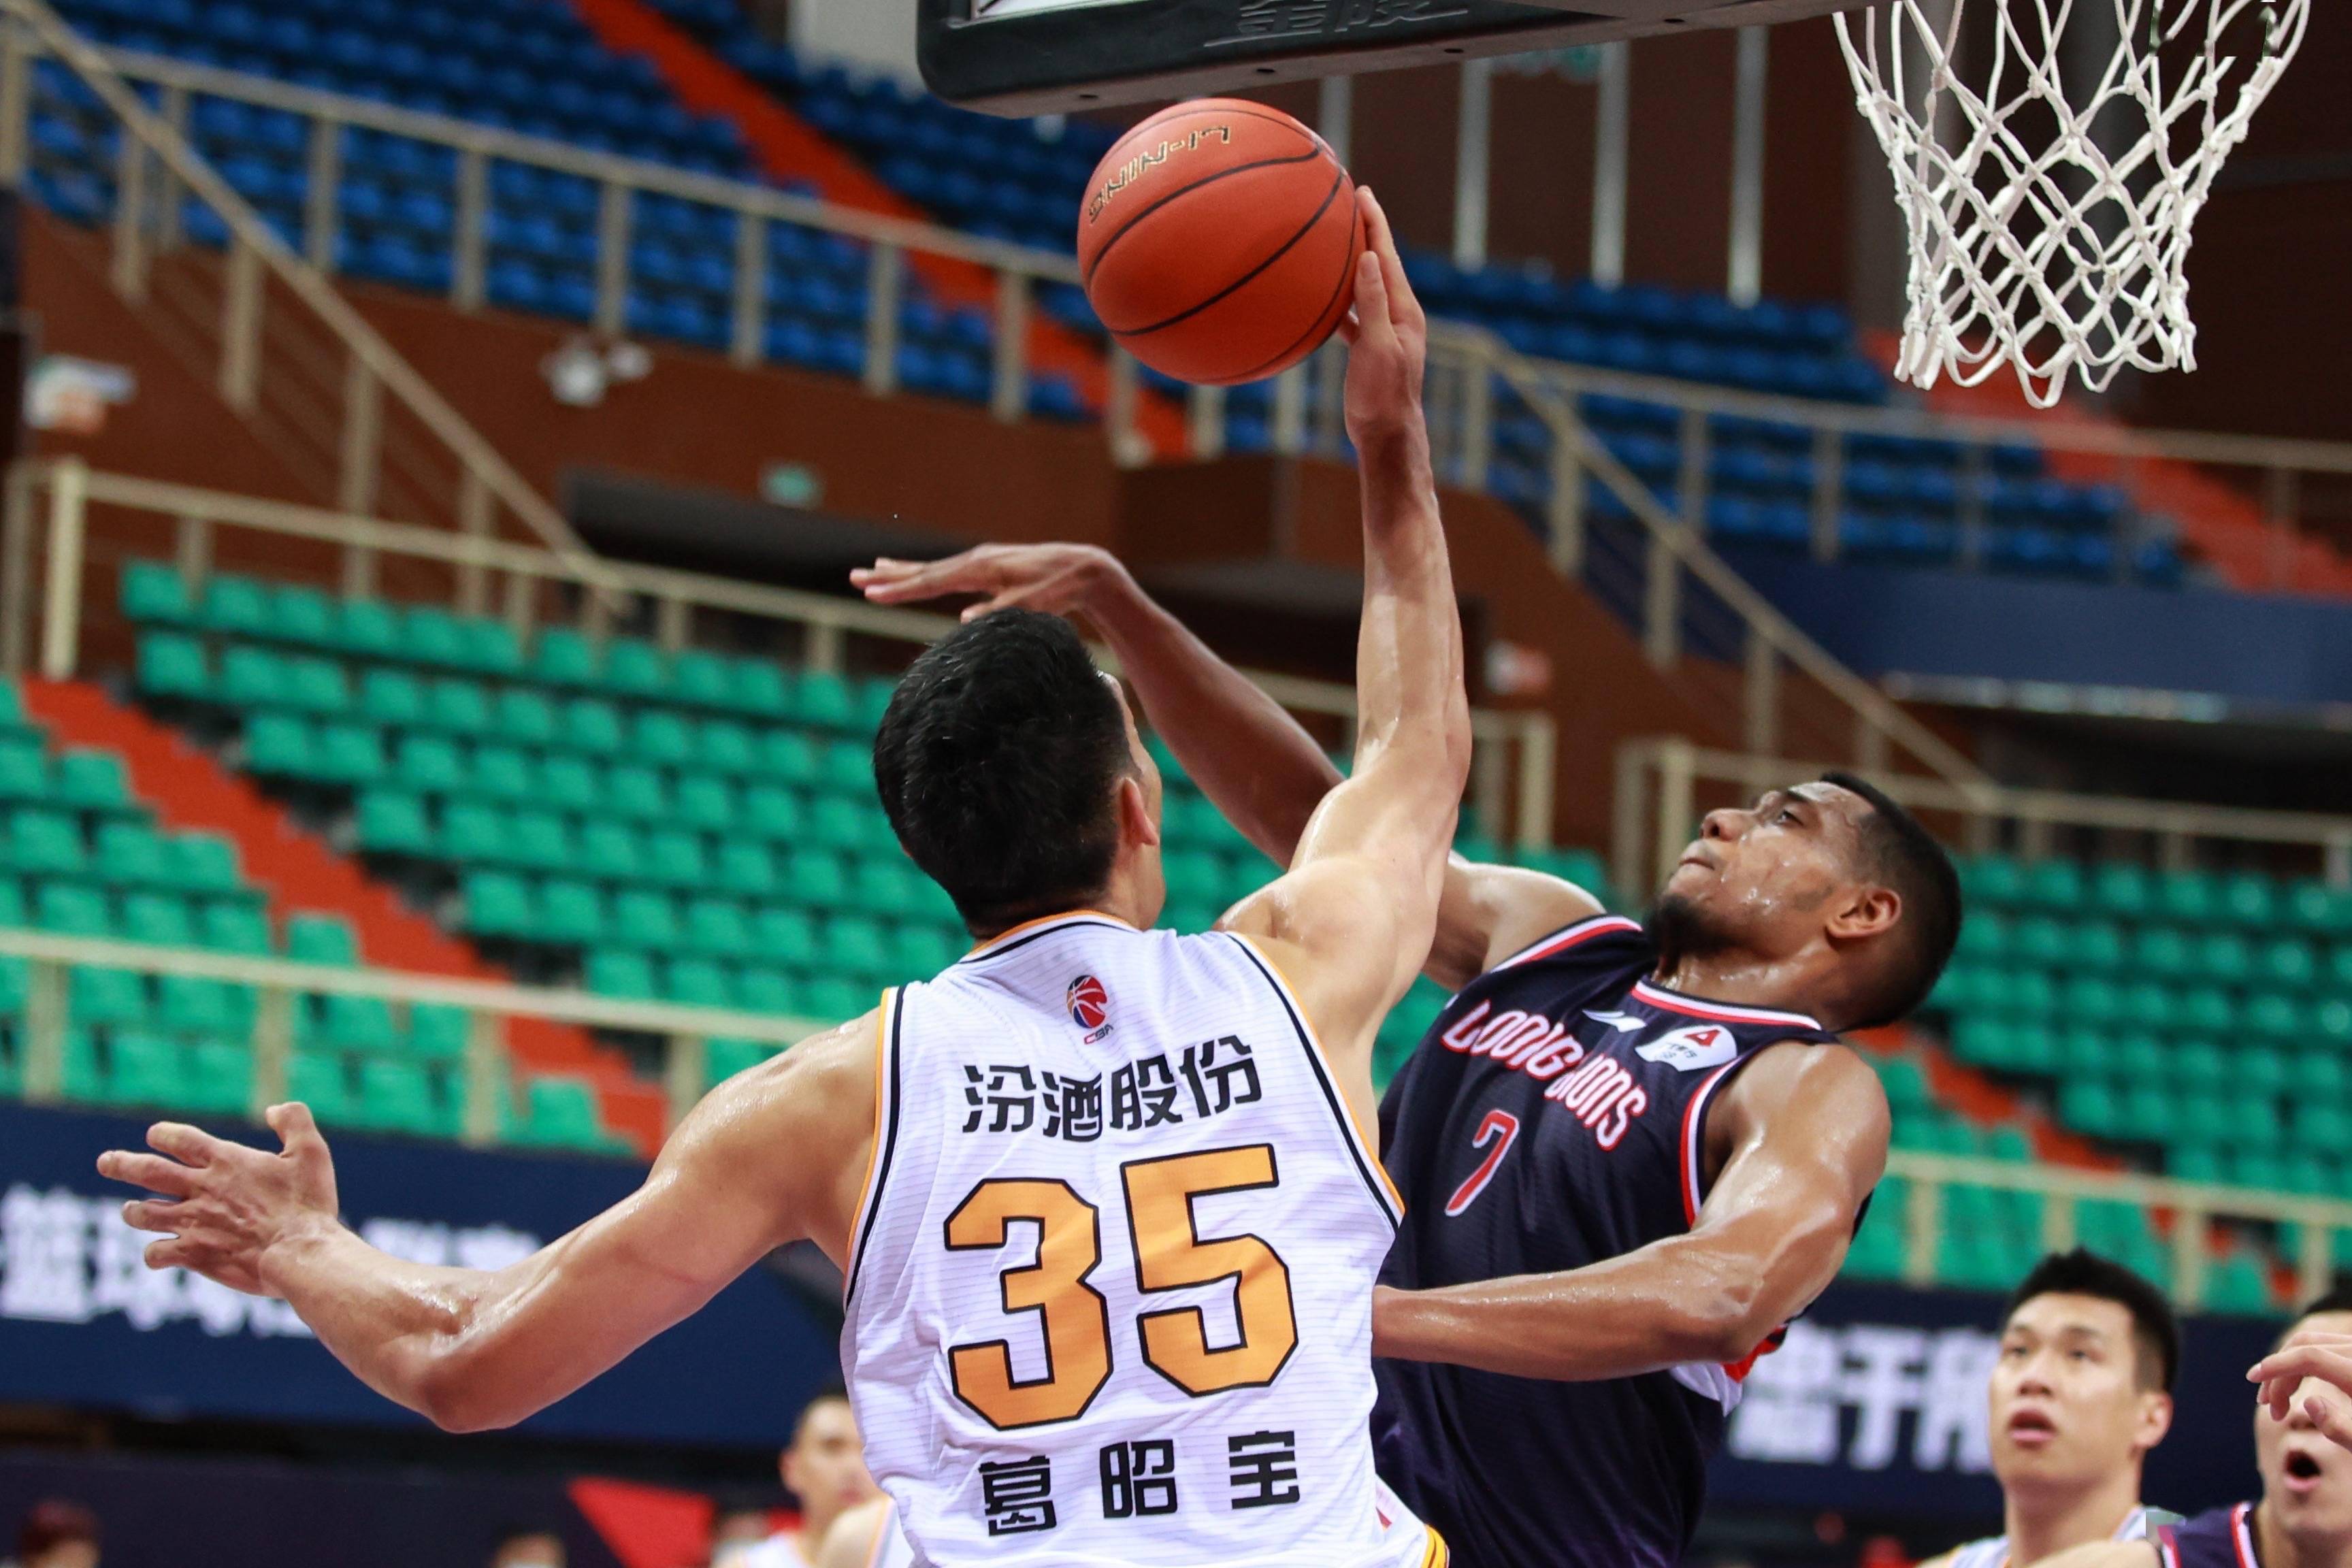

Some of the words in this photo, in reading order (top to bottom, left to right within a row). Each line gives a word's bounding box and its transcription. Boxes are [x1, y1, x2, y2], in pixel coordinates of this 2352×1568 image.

[1088, 125, 1230, 227] LI-NING
[1083, 1023, 1114, 1045] CBA
[962, 1034, 1263, 1143] 汾酒股份
[1444, 1109, 1520, 1218] 7
[943, 1143, 1299, 1432] 35
[979, 1430, 1301, 1537] 葛昭宝
